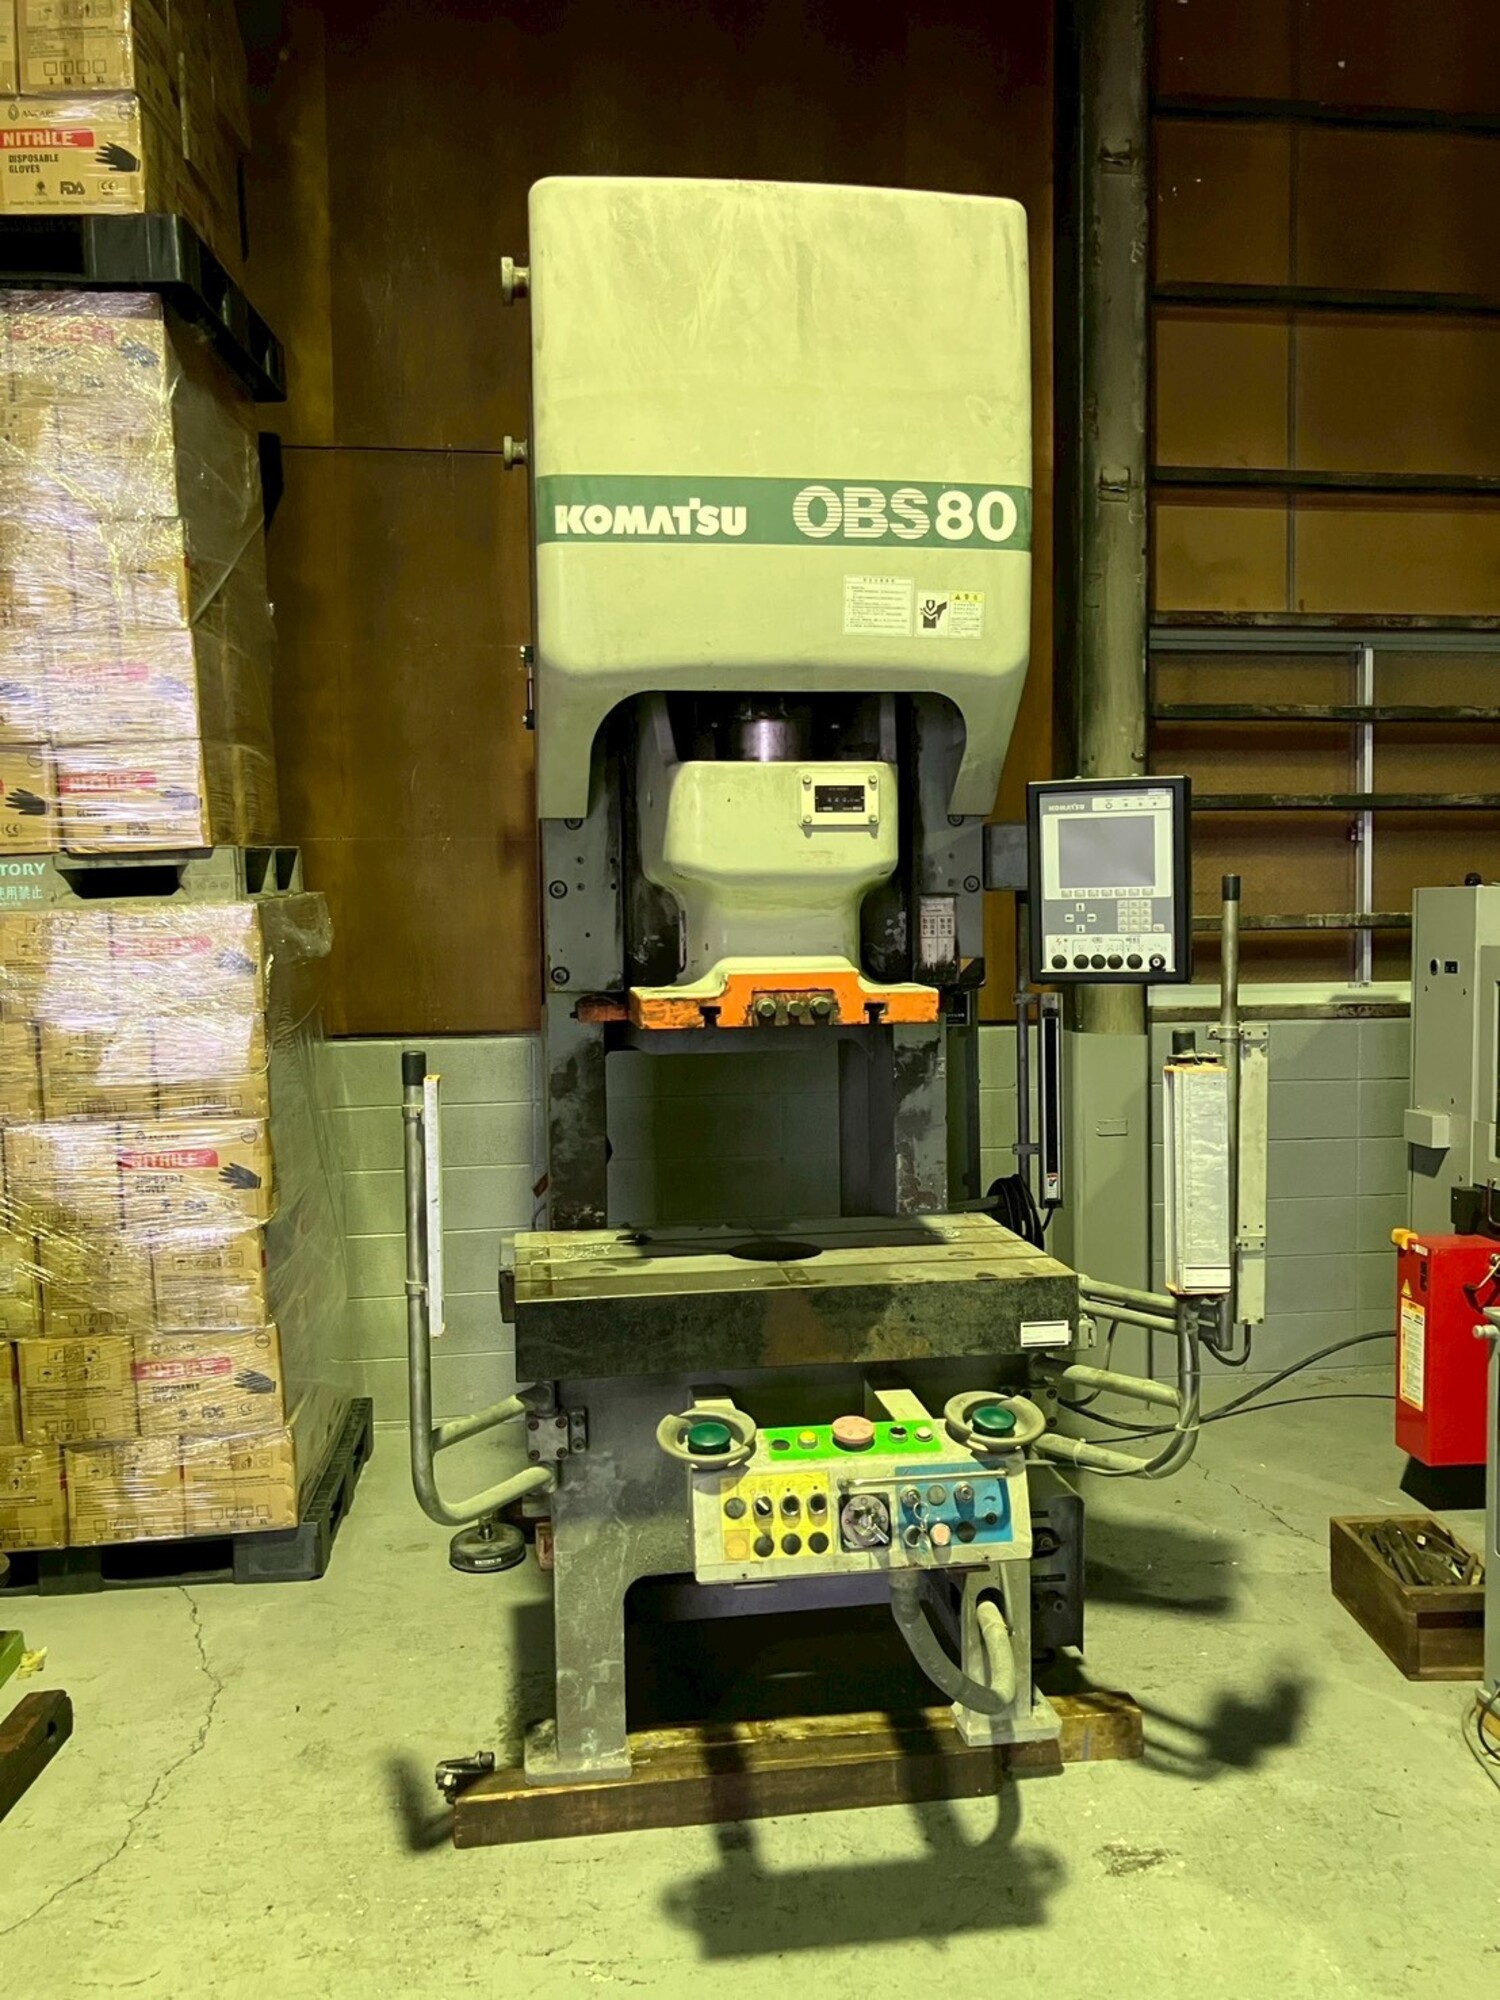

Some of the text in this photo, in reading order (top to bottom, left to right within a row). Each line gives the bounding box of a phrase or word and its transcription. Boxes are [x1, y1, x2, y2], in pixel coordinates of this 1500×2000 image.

[3, 129, 77, 147] NITRILE
[8, 153, 59, 163] DISPOSABLE
[8, 164, 40, 173] GLOVES
[60, 180, 85, 195] FDA
[554, 497, 748, 537] KOMATSU
